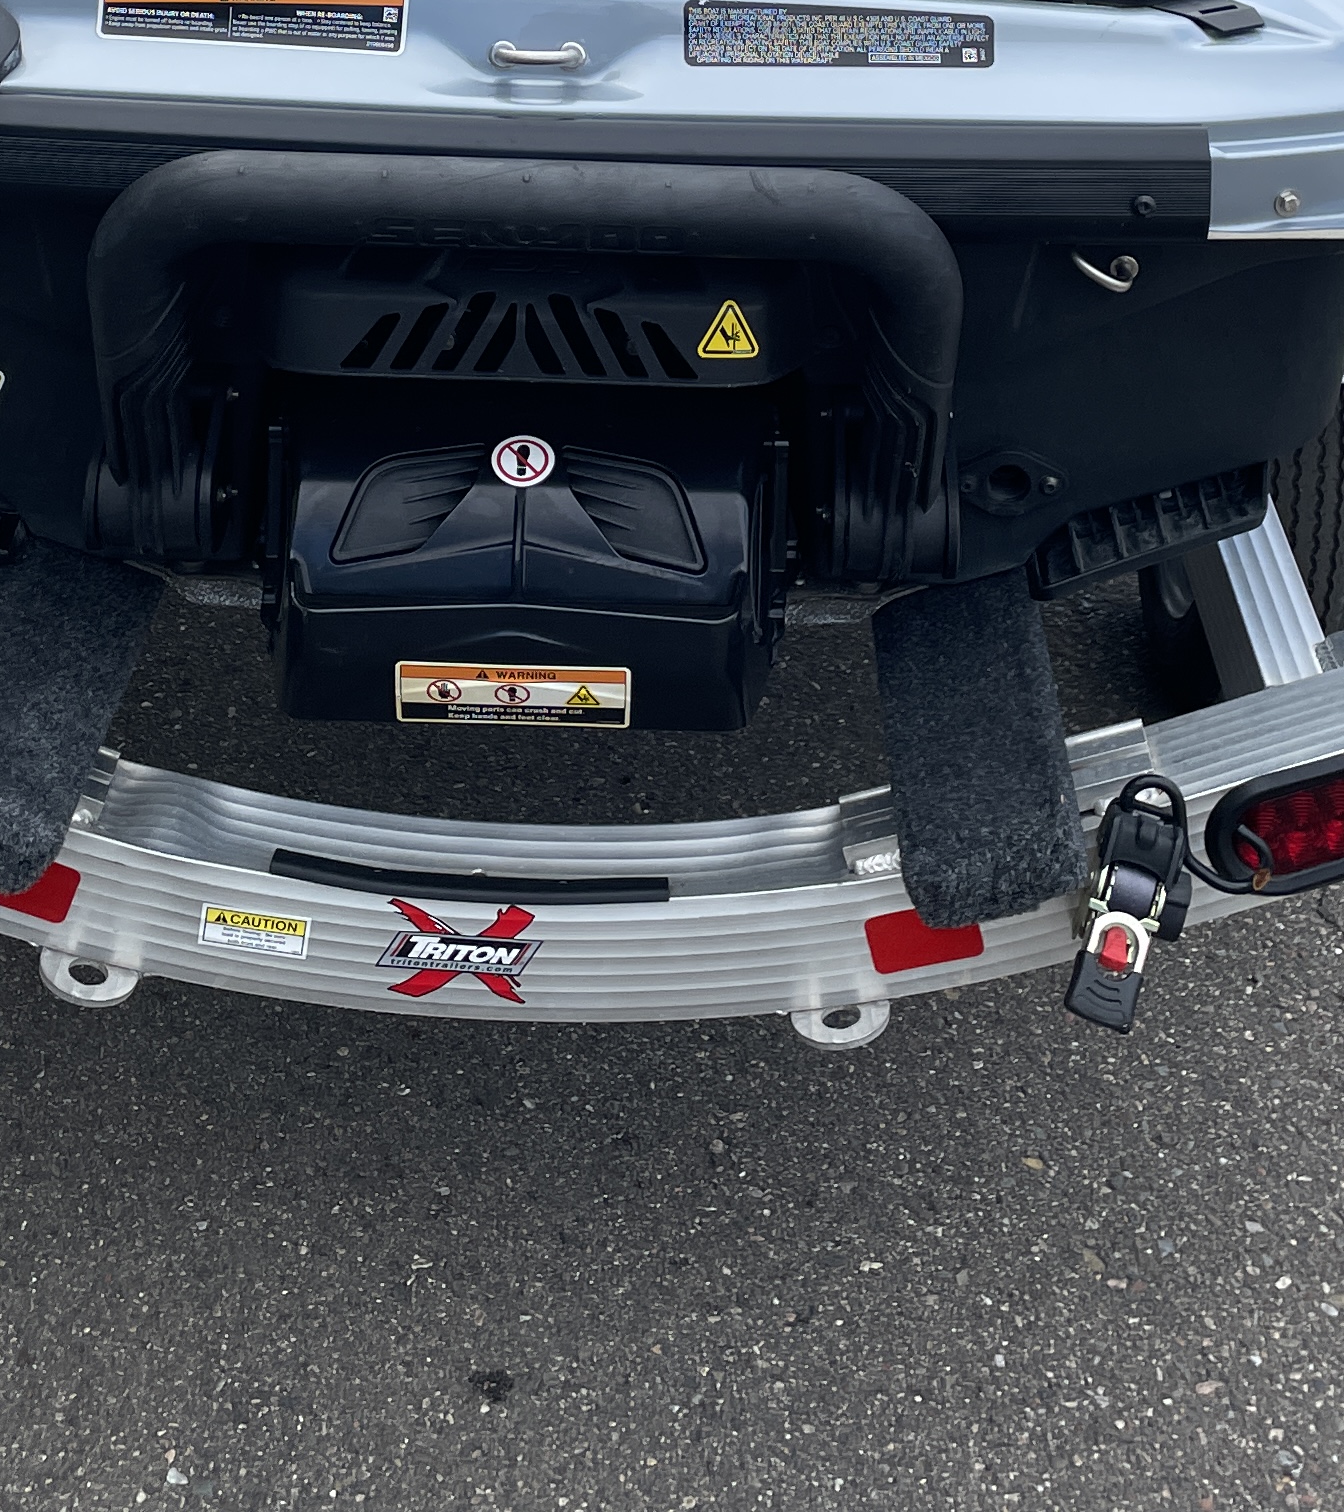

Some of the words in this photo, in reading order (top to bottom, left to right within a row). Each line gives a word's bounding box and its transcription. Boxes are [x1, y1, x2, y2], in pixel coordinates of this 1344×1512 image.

[495, 670, 557, 681] WARNING
[447, 704, 481, 713] Moving
[482, 706, 505, 714] parts
[447, 712, 471, 720] Keep
[230, 913, 298, 933] CAUTION
[408, 935, 520, 966] TRITON
[390, 958, 514, 974] tritontrailers.com
